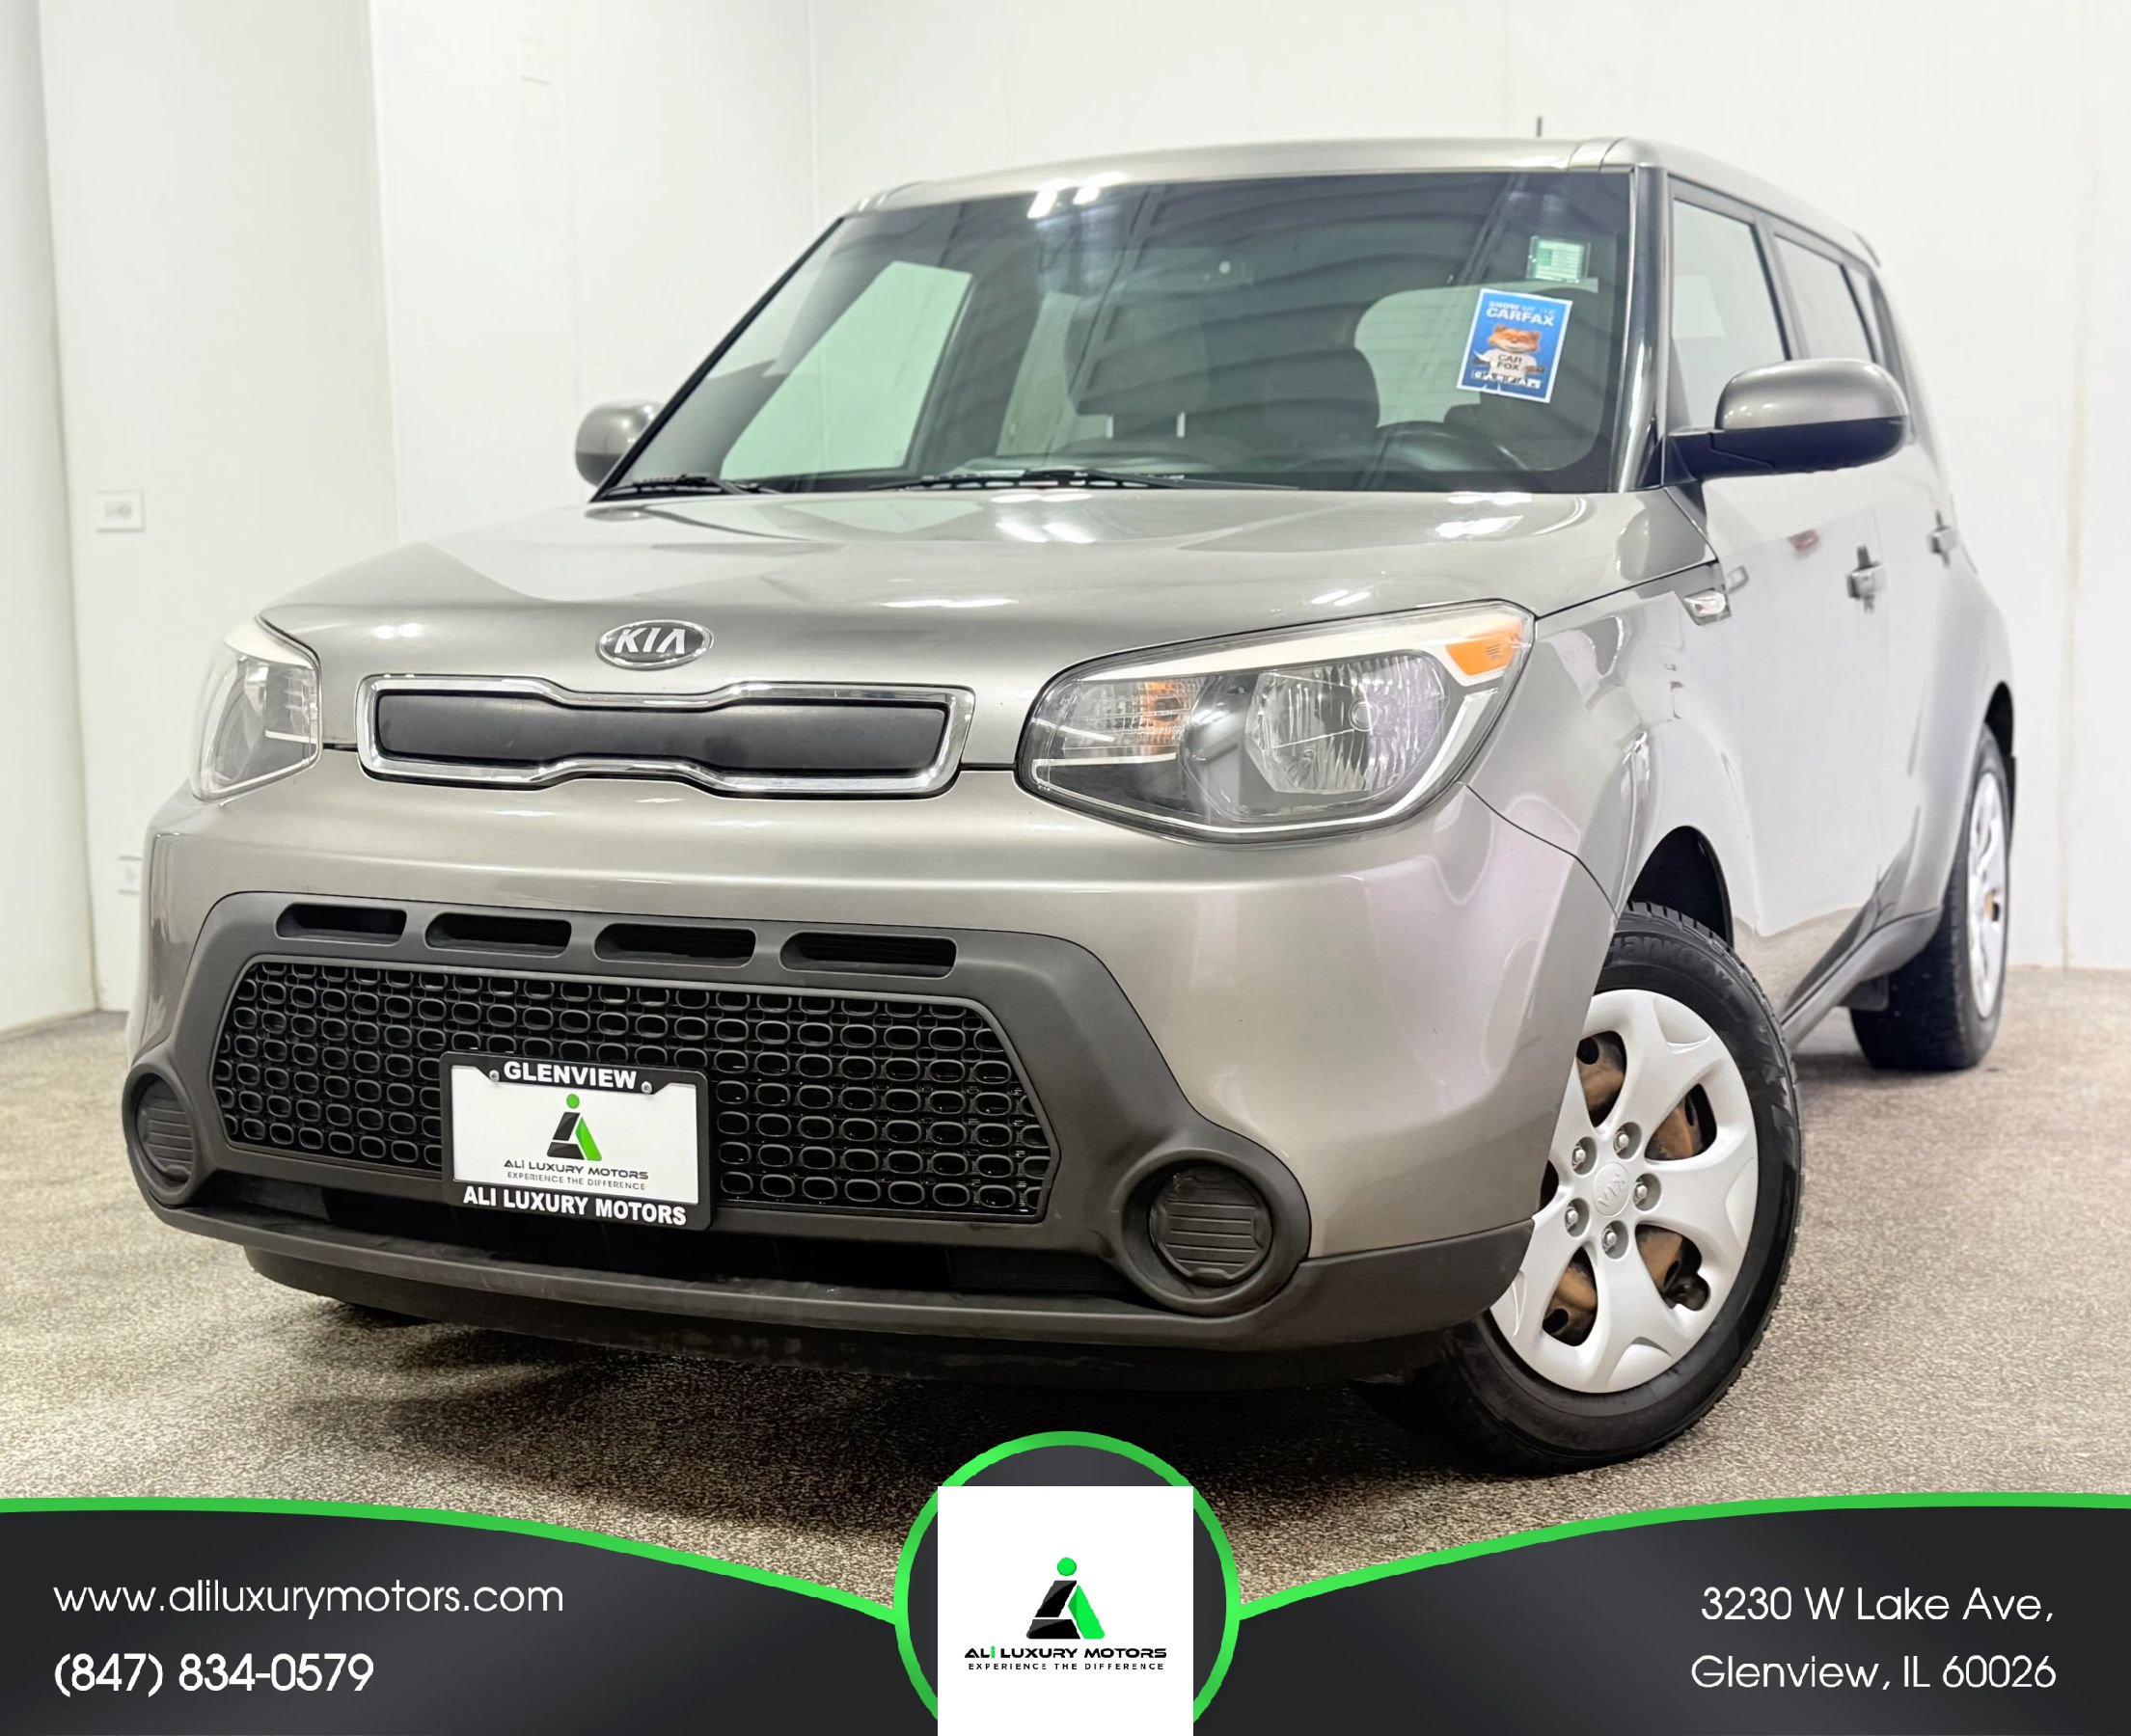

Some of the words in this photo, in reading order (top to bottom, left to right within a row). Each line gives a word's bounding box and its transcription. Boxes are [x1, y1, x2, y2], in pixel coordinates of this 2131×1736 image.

[1486, 308, 1555, 327] CARFAX
[1496, 362, 1520, 371] FOX
[1497, 354, 1523, 364] CAR
[614, 627, 686, 655] KIA
[504, 1061, 638, 1090] GLENVIEW
[528, 1161, 585, 1175] LUXURY
[587, 1167, 649, 1180] MOTORS
[507, 1172, 564, 1184] EXPERIENCE
[567, 1177, 584, 1186] THE
[587, 1179, 646, 1191] DIFFERENCE
[463, 1186, 497, 1207] ALI
[503, 1189, 589, 1216] LUXURY
[595, 1198, 687, 1226] MOTORS
